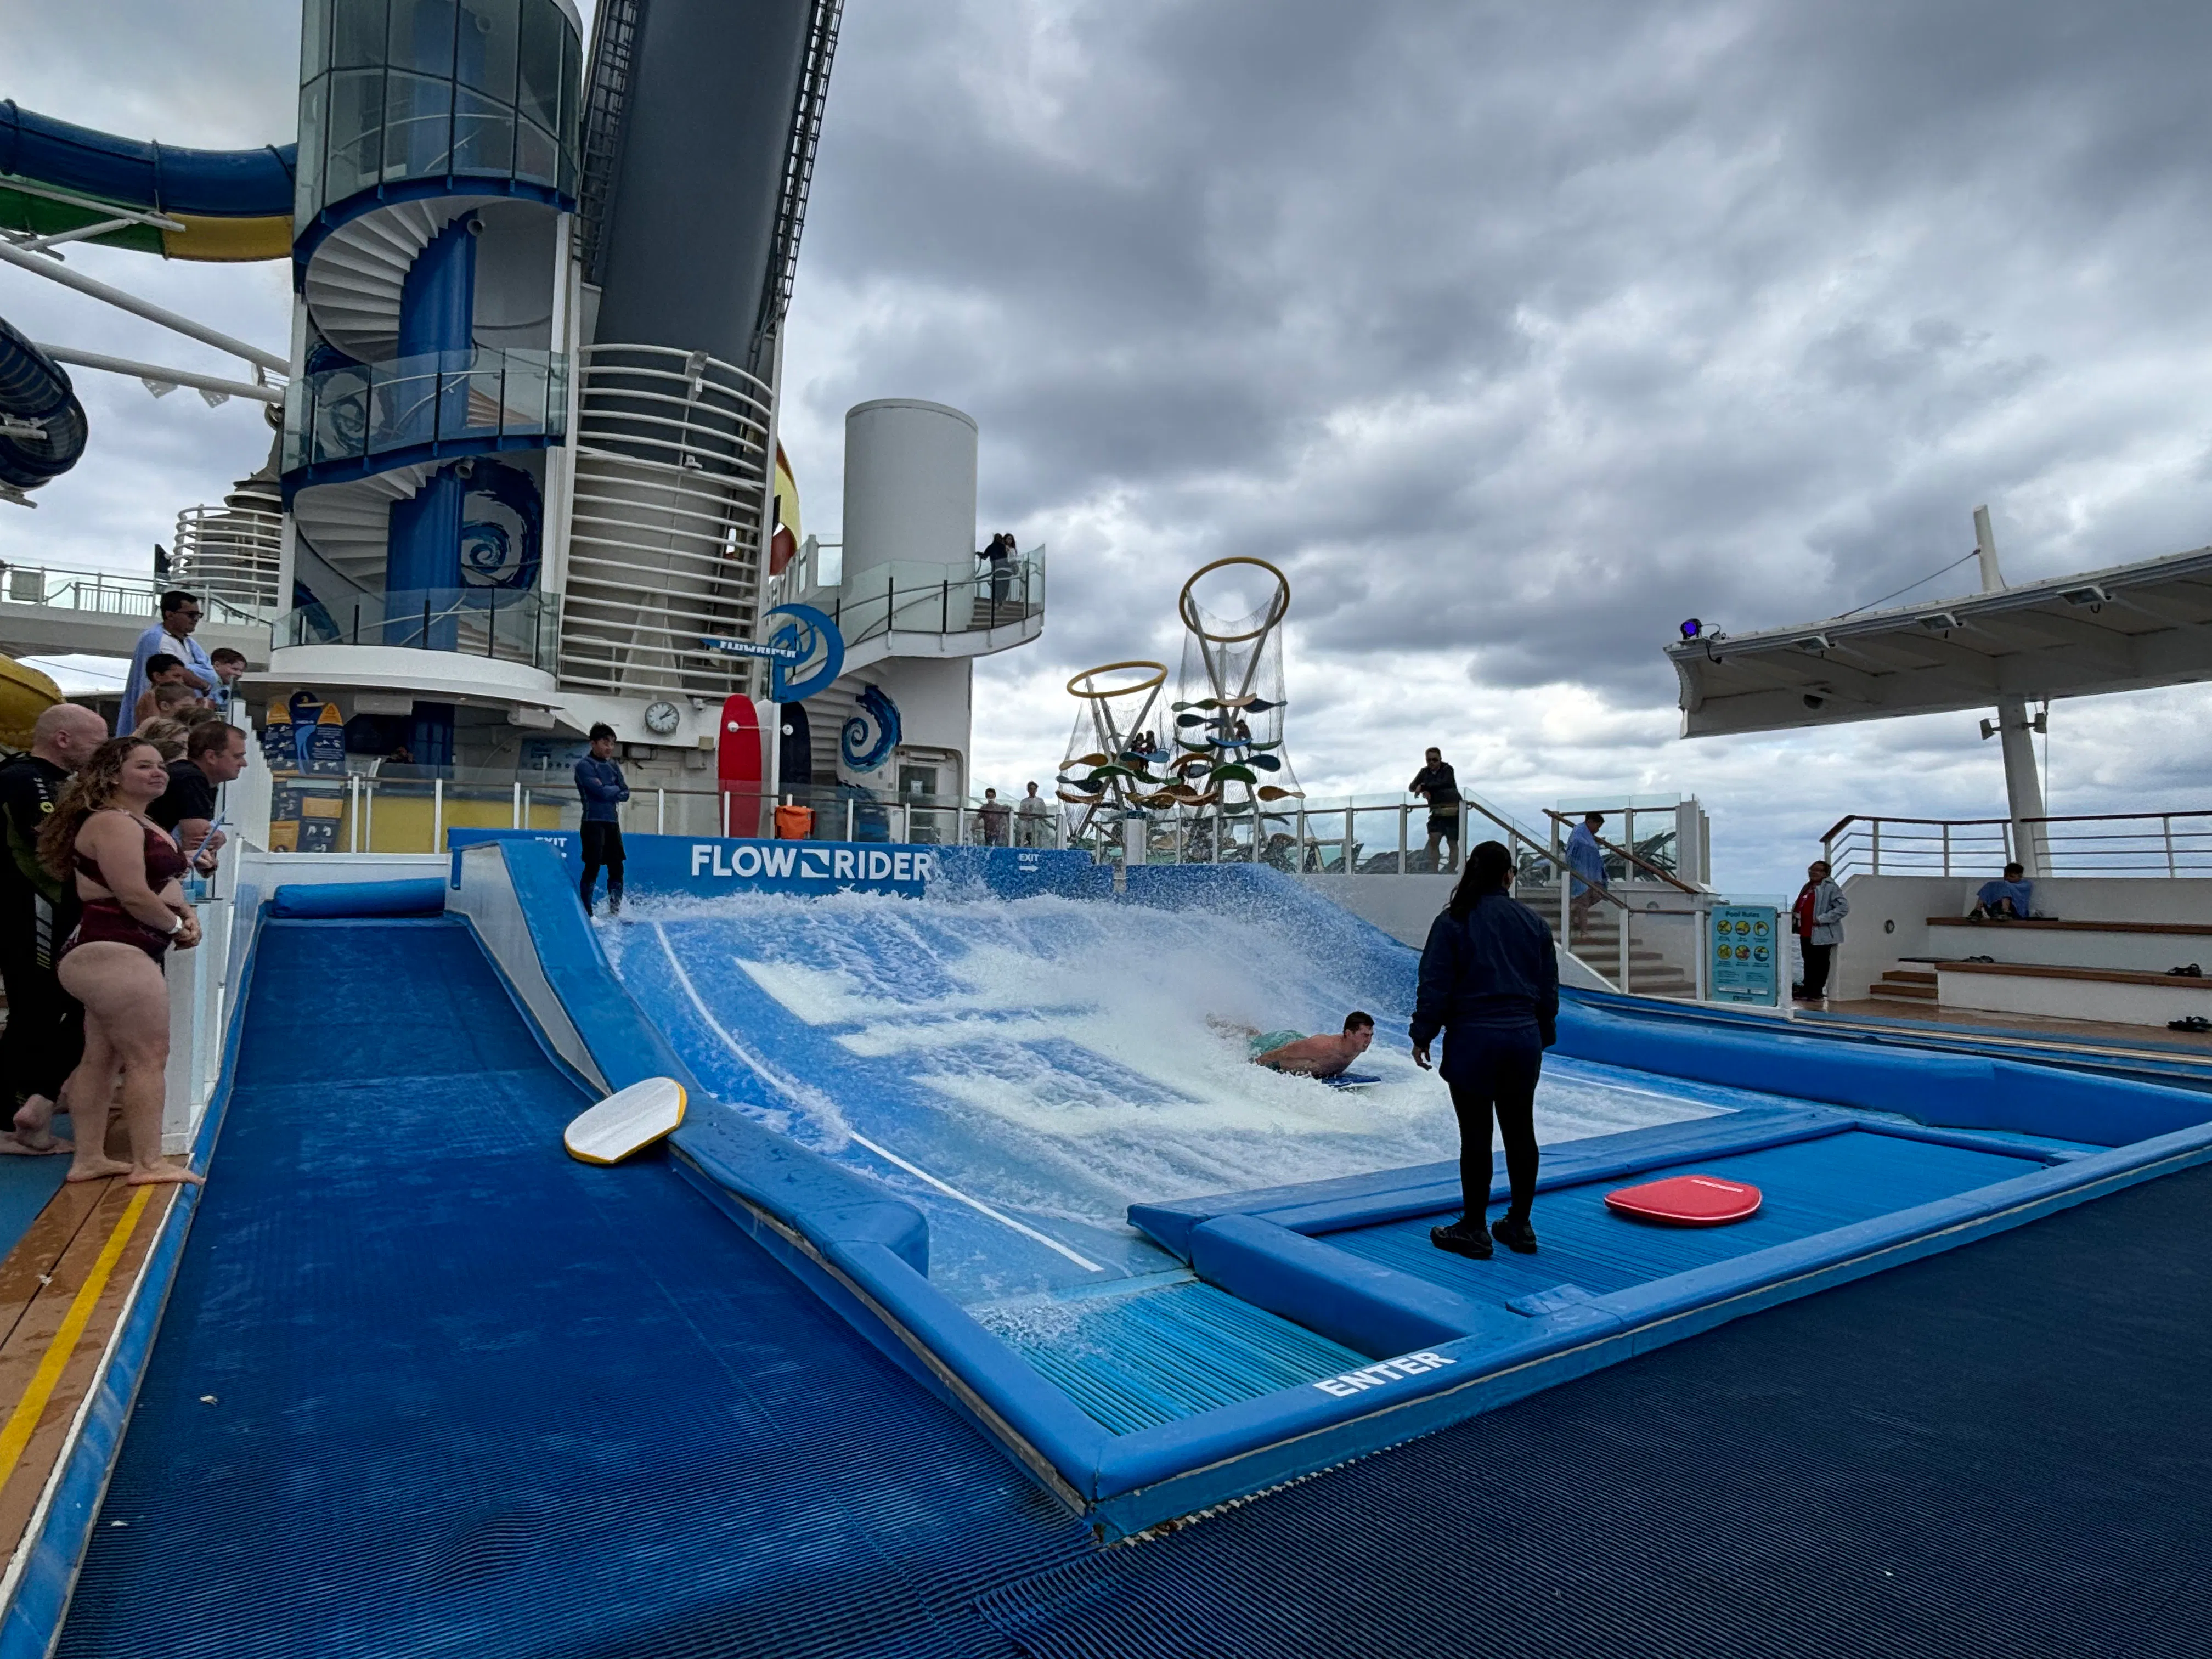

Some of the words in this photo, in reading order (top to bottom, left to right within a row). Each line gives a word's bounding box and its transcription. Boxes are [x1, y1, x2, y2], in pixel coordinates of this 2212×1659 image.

[691, 844, 797, 878] FLOW
[834, 849, 932, 881] RIDER
[1313, 1352, 1457, 1397] ENTER
